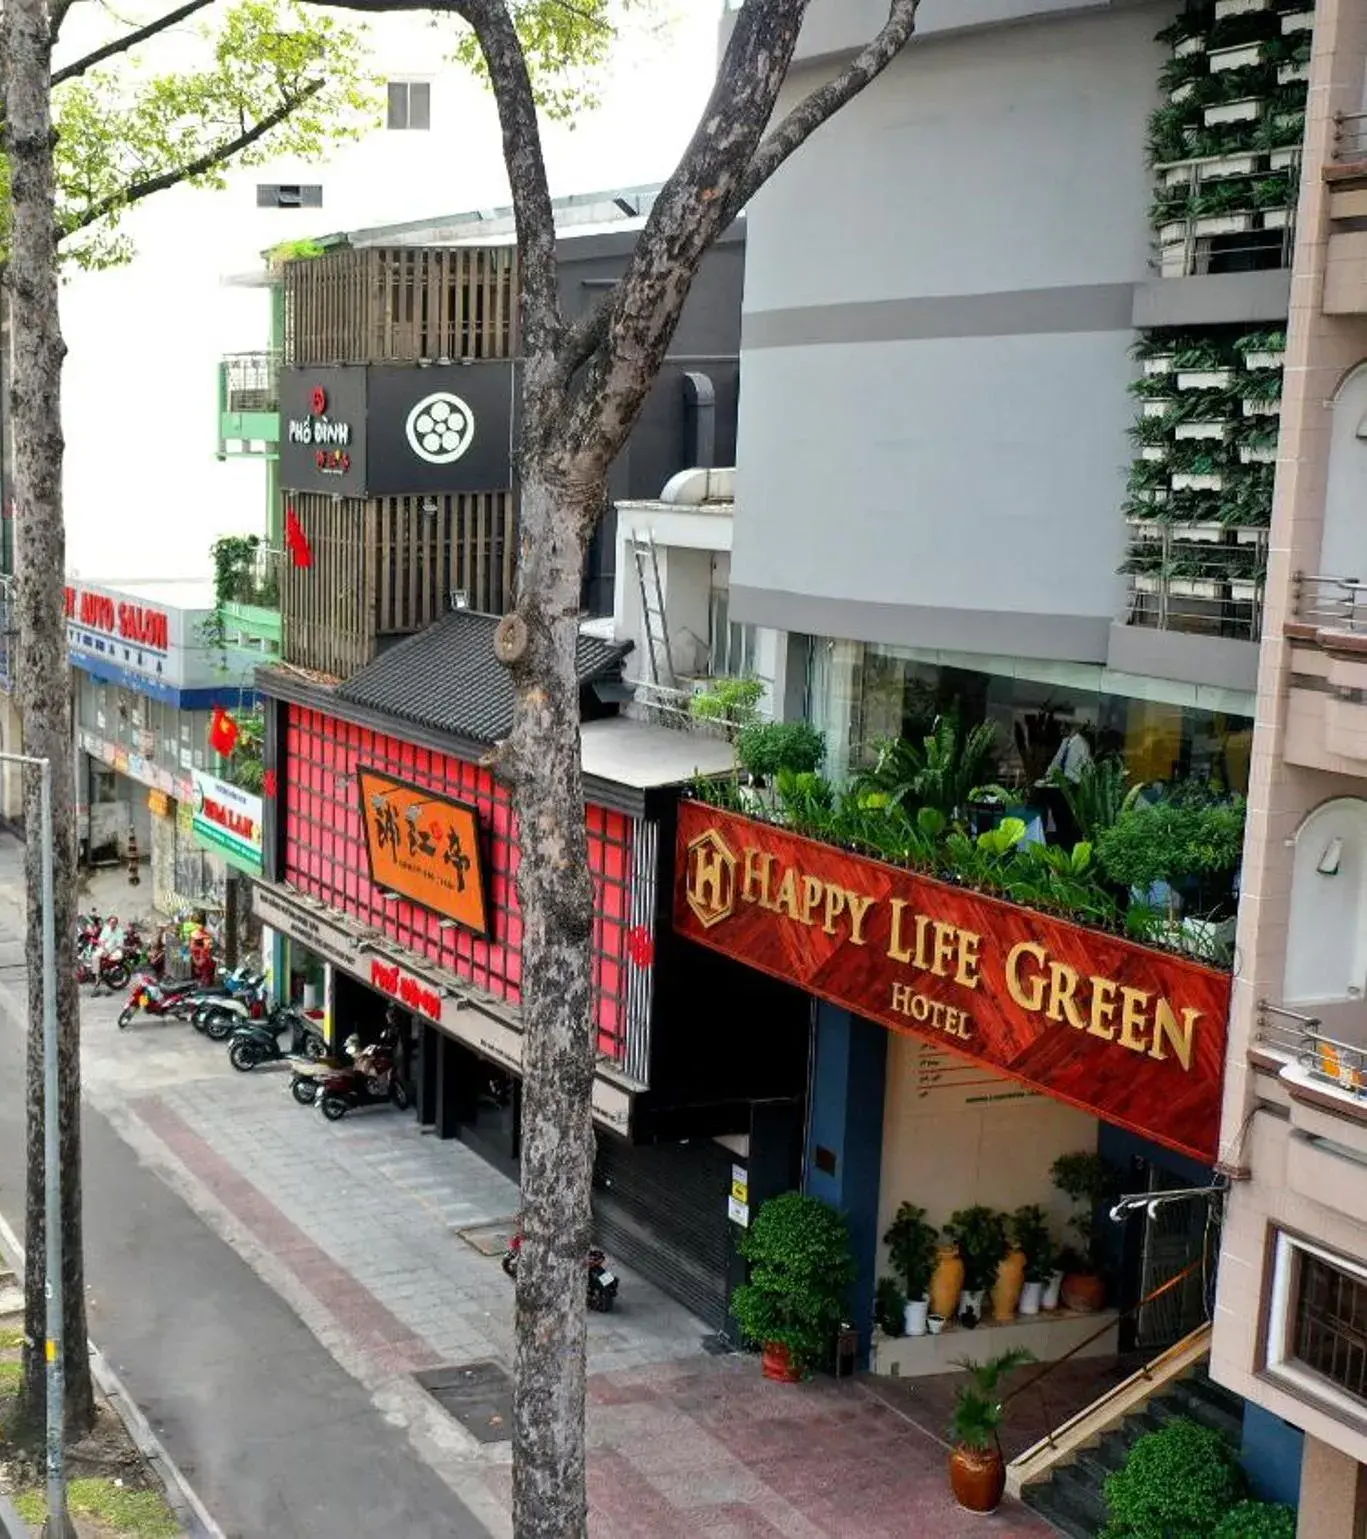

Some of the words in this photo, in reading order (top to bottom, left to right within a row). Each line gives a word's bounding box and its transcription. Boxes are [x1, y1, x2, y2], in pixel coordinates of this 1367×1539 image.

[81, 592, 114, 633] AUTO
[118, 600, 168, 651] SALON
[741, 848, 875, 946] HAPPY
[886, 898, 981, 989] LIFE
[1005, 941, 1204, 1072] GREEN
[890, 982, 973, 1040] HOTEL
